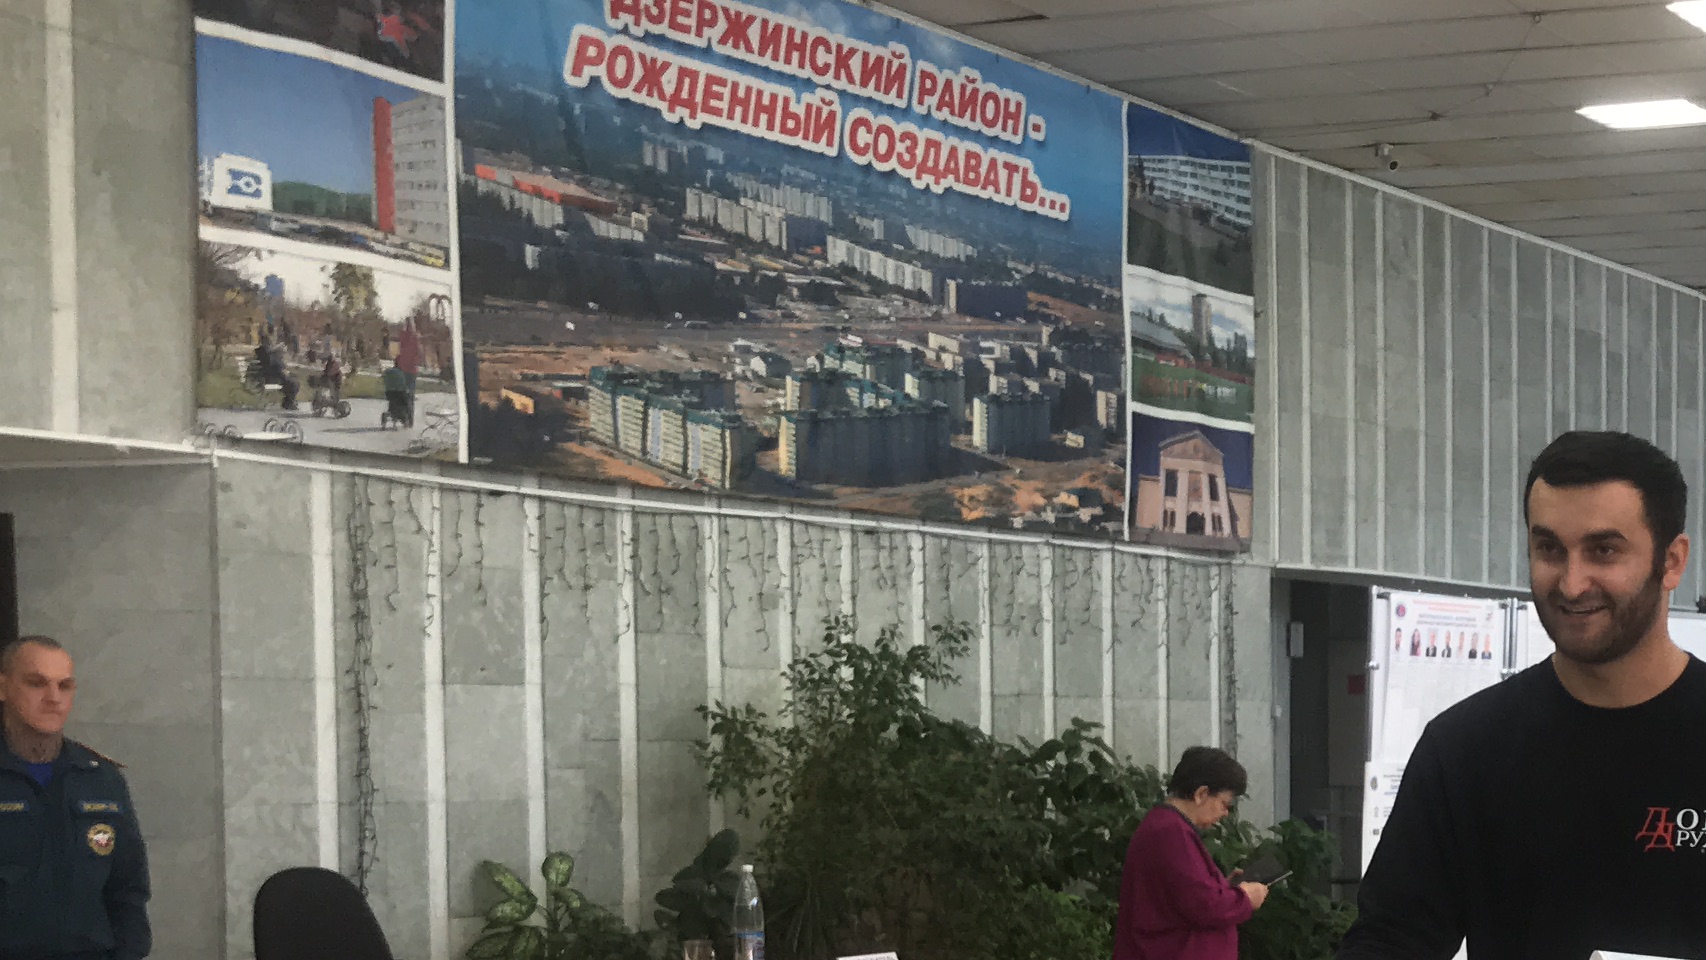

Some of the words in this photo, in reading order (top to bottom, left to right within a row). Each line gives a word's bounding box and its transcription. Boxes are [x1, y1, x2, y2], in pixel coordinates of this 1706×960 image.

[570, 33, 838, 149] РОЖДЕННЫЙ
[849, 116, 1067, 214] СОЗДАВАТЬ...
[917, 69, 1023, 136] РАЙОН
